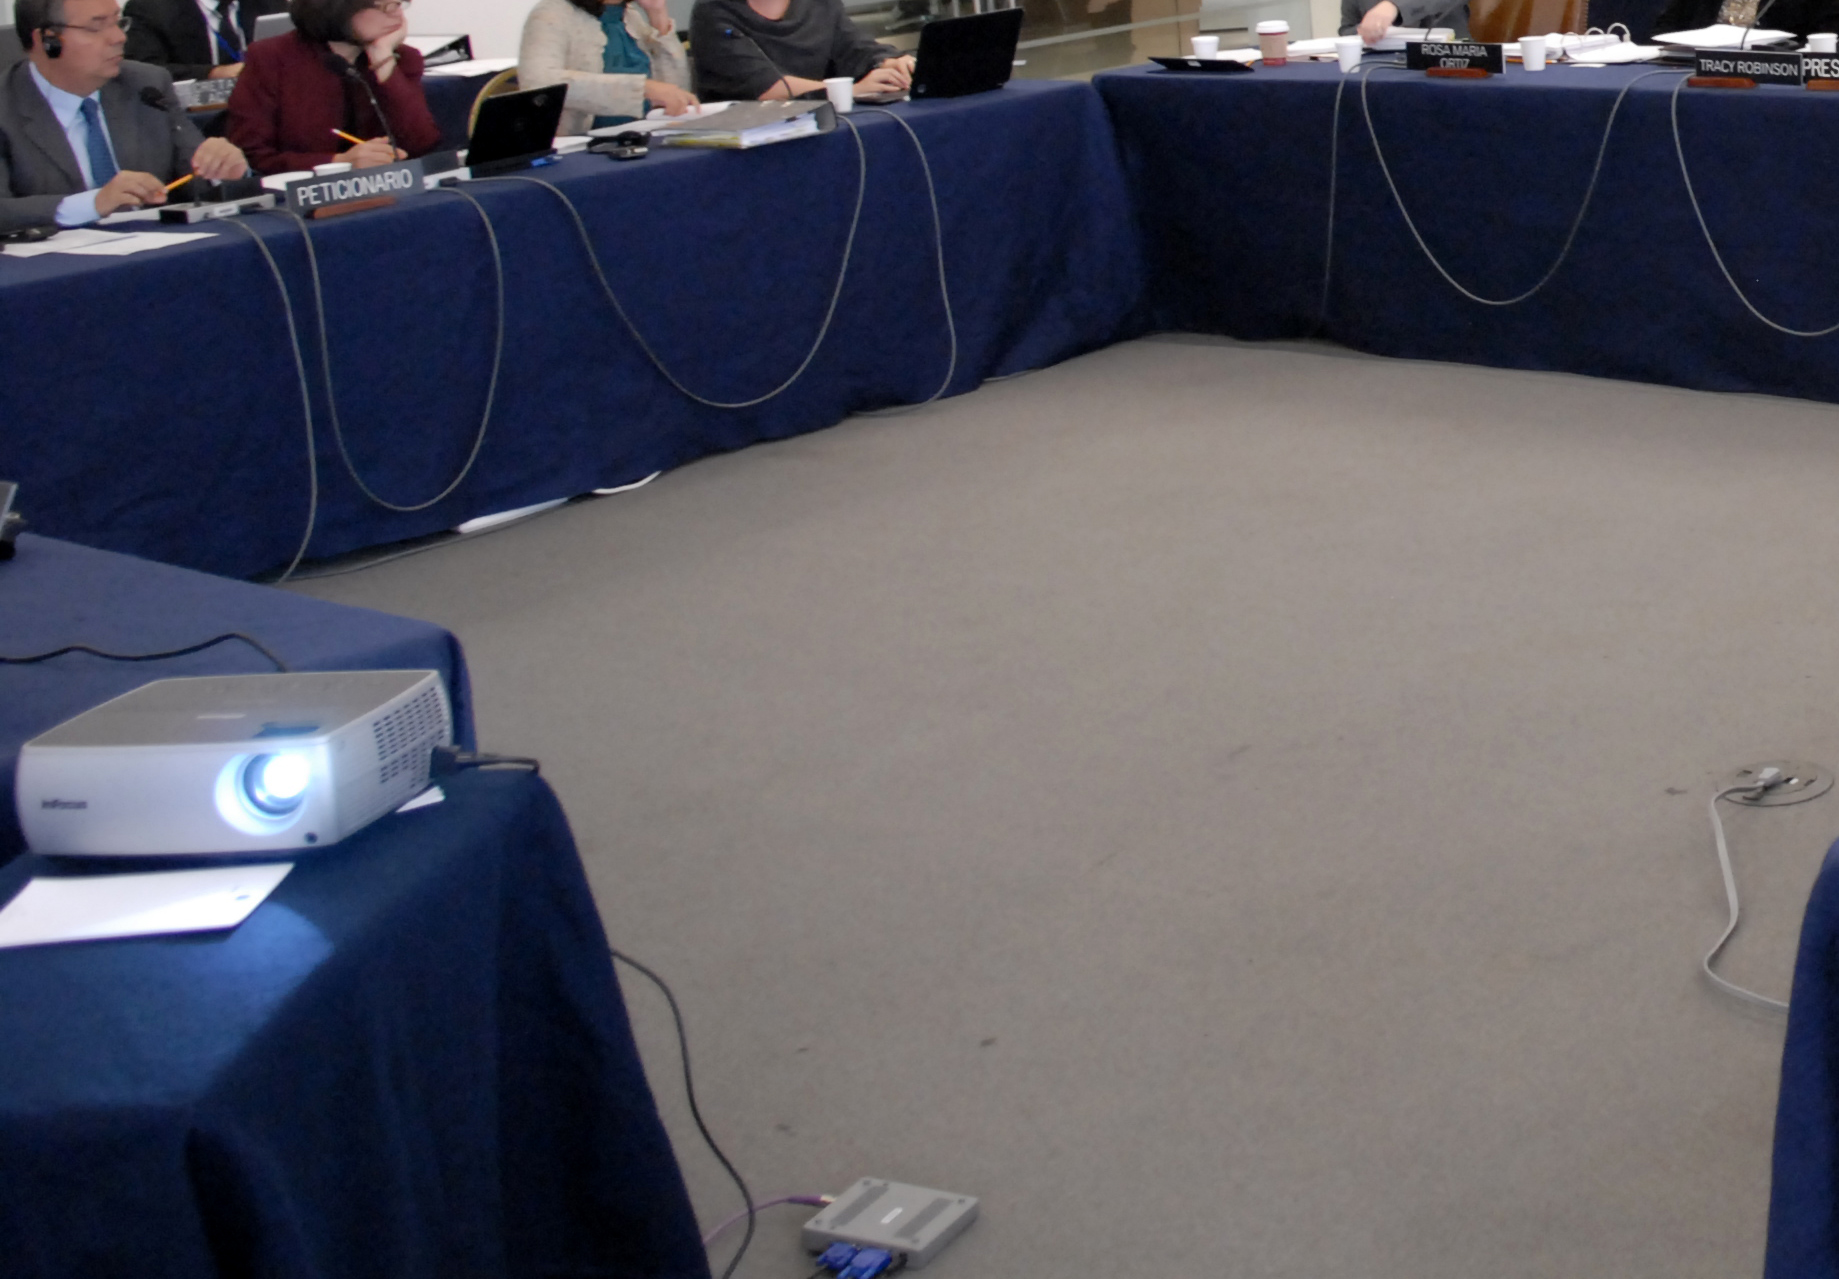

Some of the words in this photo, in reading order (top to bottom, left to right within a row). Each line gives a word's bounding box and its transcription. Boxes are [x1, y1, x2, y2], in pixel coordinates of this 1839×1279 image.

[1421, 43, 1450, 56] ROSA
[1452, 45, 1488, 57] MARIA
[1699, 58, 1735, 73] TRACY
[1737, 61, 1799, 77] ROBINSON
[296, 169, 413, 206] PETICIONARIO
